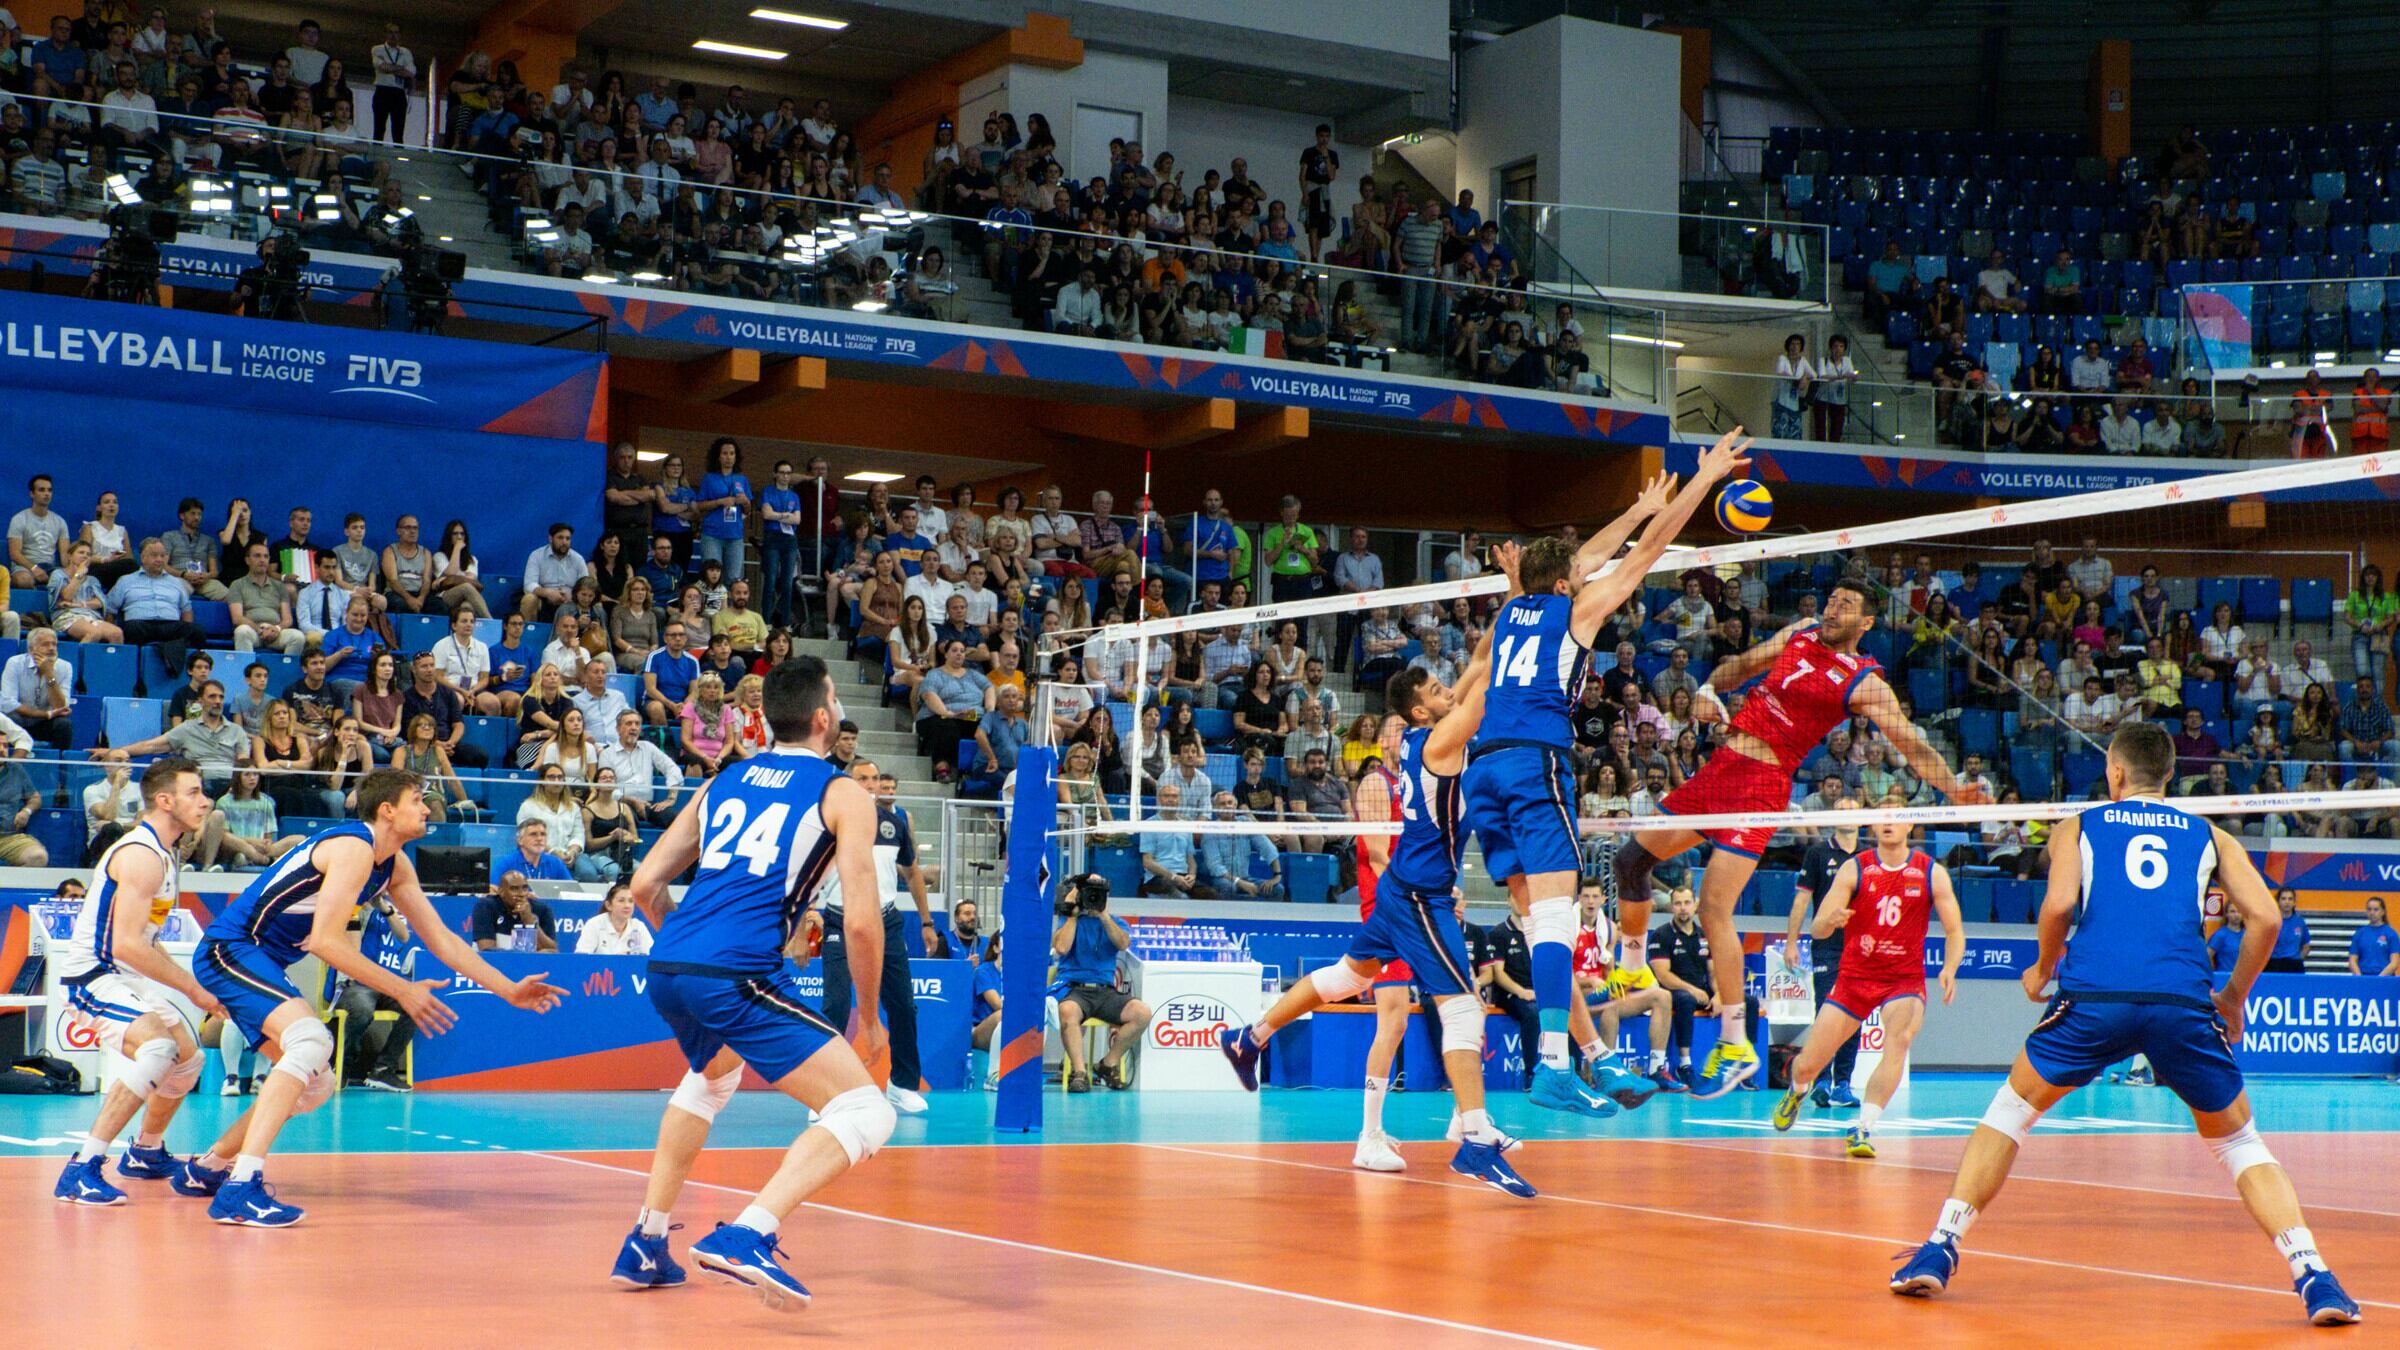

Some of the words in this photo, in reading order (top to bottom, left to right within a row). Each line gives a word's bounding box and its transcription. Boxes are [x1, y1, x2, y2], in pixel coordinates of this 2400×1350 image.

[729, 320, 842, 348] VOLLEYBALL
[845, 334, 878, 344] NATIONS
[886, 338, 916, 352] FIVB
[0, 322, 233, 375] LLEYBALL
[844, 342, 873, 351] LEAGUE
[241, 362, 314, 383] LEAGUE
[243, 343, 326, 366] NATIONS
[348, 354, 422, 387] FIVB
[1250, 376, 1347, 401] VOLLEYBALL
[1349, 395, 1374, 404] LEAGUE
[1350, 387, 1378, 397] NATIONS
[1384, 391, 1411, 405] FIVB
[1980, 472, 2084, 489] VOLLEYBALL
[2086, 475, 2118, 483] NATIONS
[2086, 482, 2115, 490] LEAGUE
[1495, 635, 1541, 687] 14
[1781, 658, 1816, 690] 7
[741, 765, 795, 788] PINALI
[2104, 809, 2189, 830] GIANNELLI
[701, 798, 791, 877] 24
[2125, 834, 2169, 890] 6
[1876, 895, 1902, 927] 16
[1582, 946, 1600, 970] 20
[1983, 950, 2012, 964] FIVB
[1168, 1003, 1225, 1022] 百岁山
[2245, 996, 2400, 1028] VOLLEYBAL
[2243, 1031, 2331, 1055] NATIONS
[2338, 1032, 2400, 1055] LEAGU
